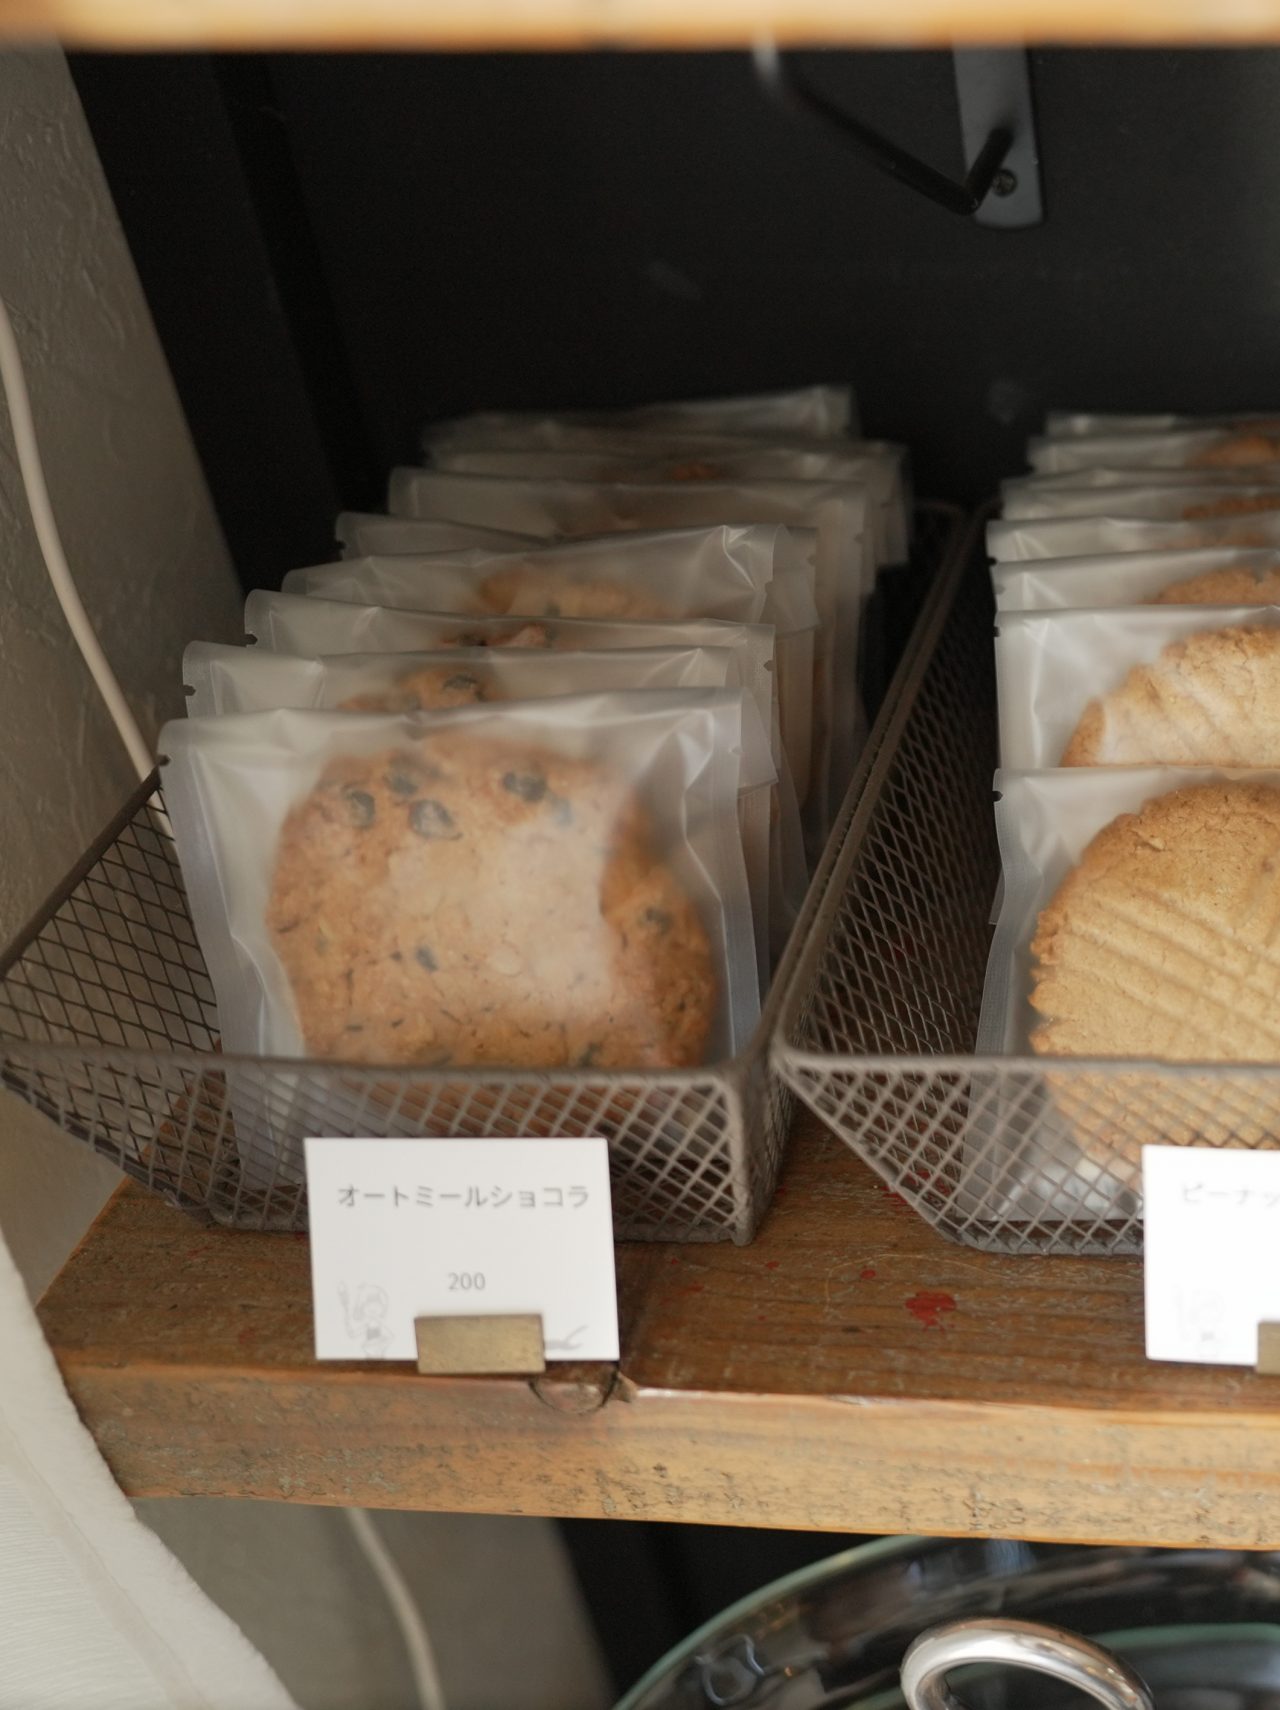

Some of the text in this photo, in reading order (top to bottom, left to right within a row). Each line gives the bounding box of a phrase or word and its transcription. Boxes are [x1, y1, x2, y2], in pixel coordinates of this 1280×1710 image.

[336, 1183, 590, 1209] オートミールショコラ
[447, 1271, 487, 1292] 200
